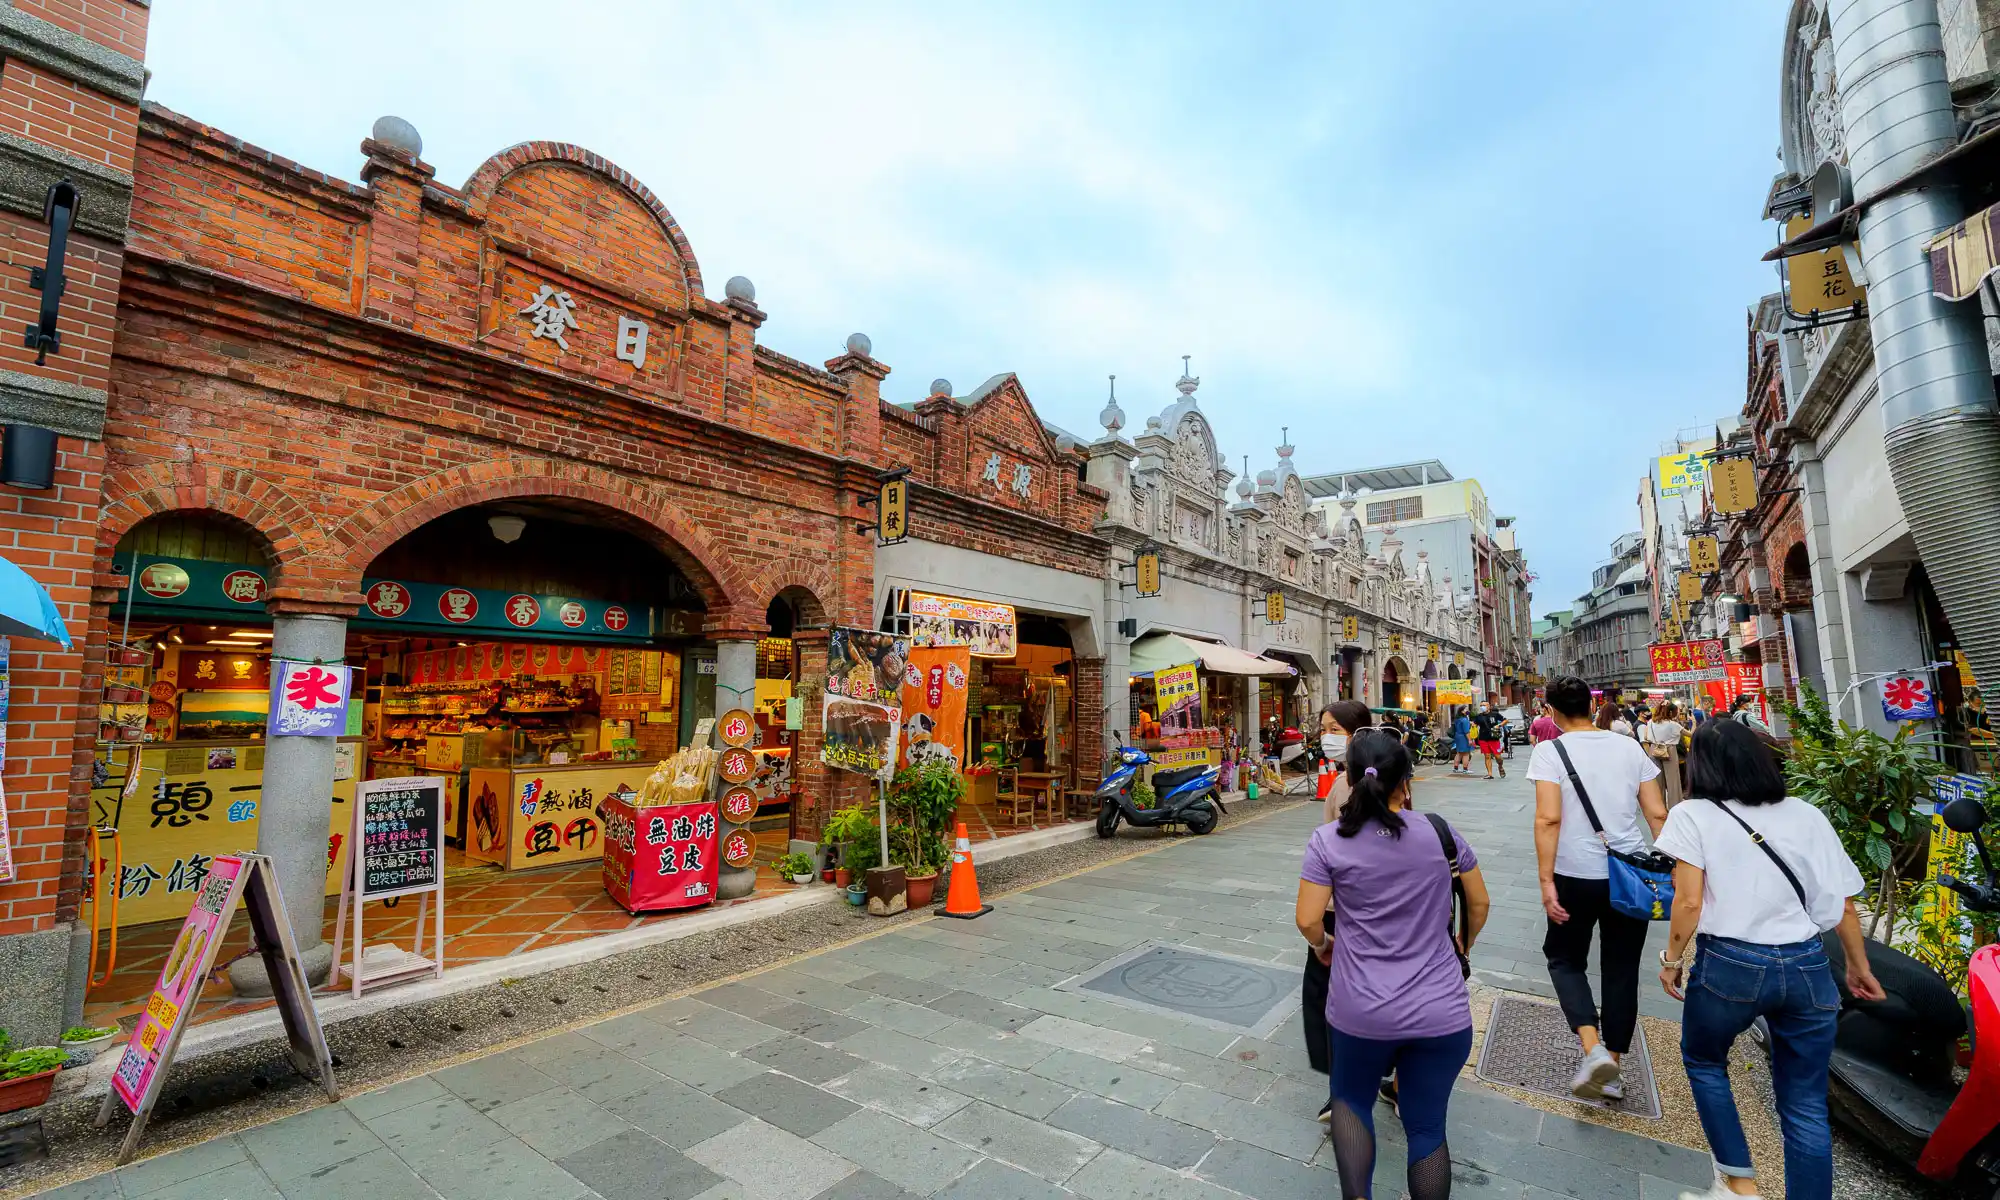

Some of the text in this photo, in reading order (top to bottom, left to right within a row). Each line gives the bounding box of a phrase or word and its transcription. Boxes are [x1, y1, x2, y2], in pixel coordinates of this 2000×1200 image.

[1822, 260, 1846, 298] 豆花
[885, 487, 900, 532] 日發
[147, 570, 258, 598] 豆腐
[374, 584, 625, 628] 萬里香豆干
[195, 659, 270, 680] 萬里
[930, 668, 942, 705] 正宗
[1739, 667, 1760, 676] SET
[520, 782, 537, 817] 手切
[539, 789, 592, 814] 熱滷
[526, 818, 598, 859] 豆干
[646, 812, 715, 845] 無油炸
[658, 844, 703, 876] 豆皮
